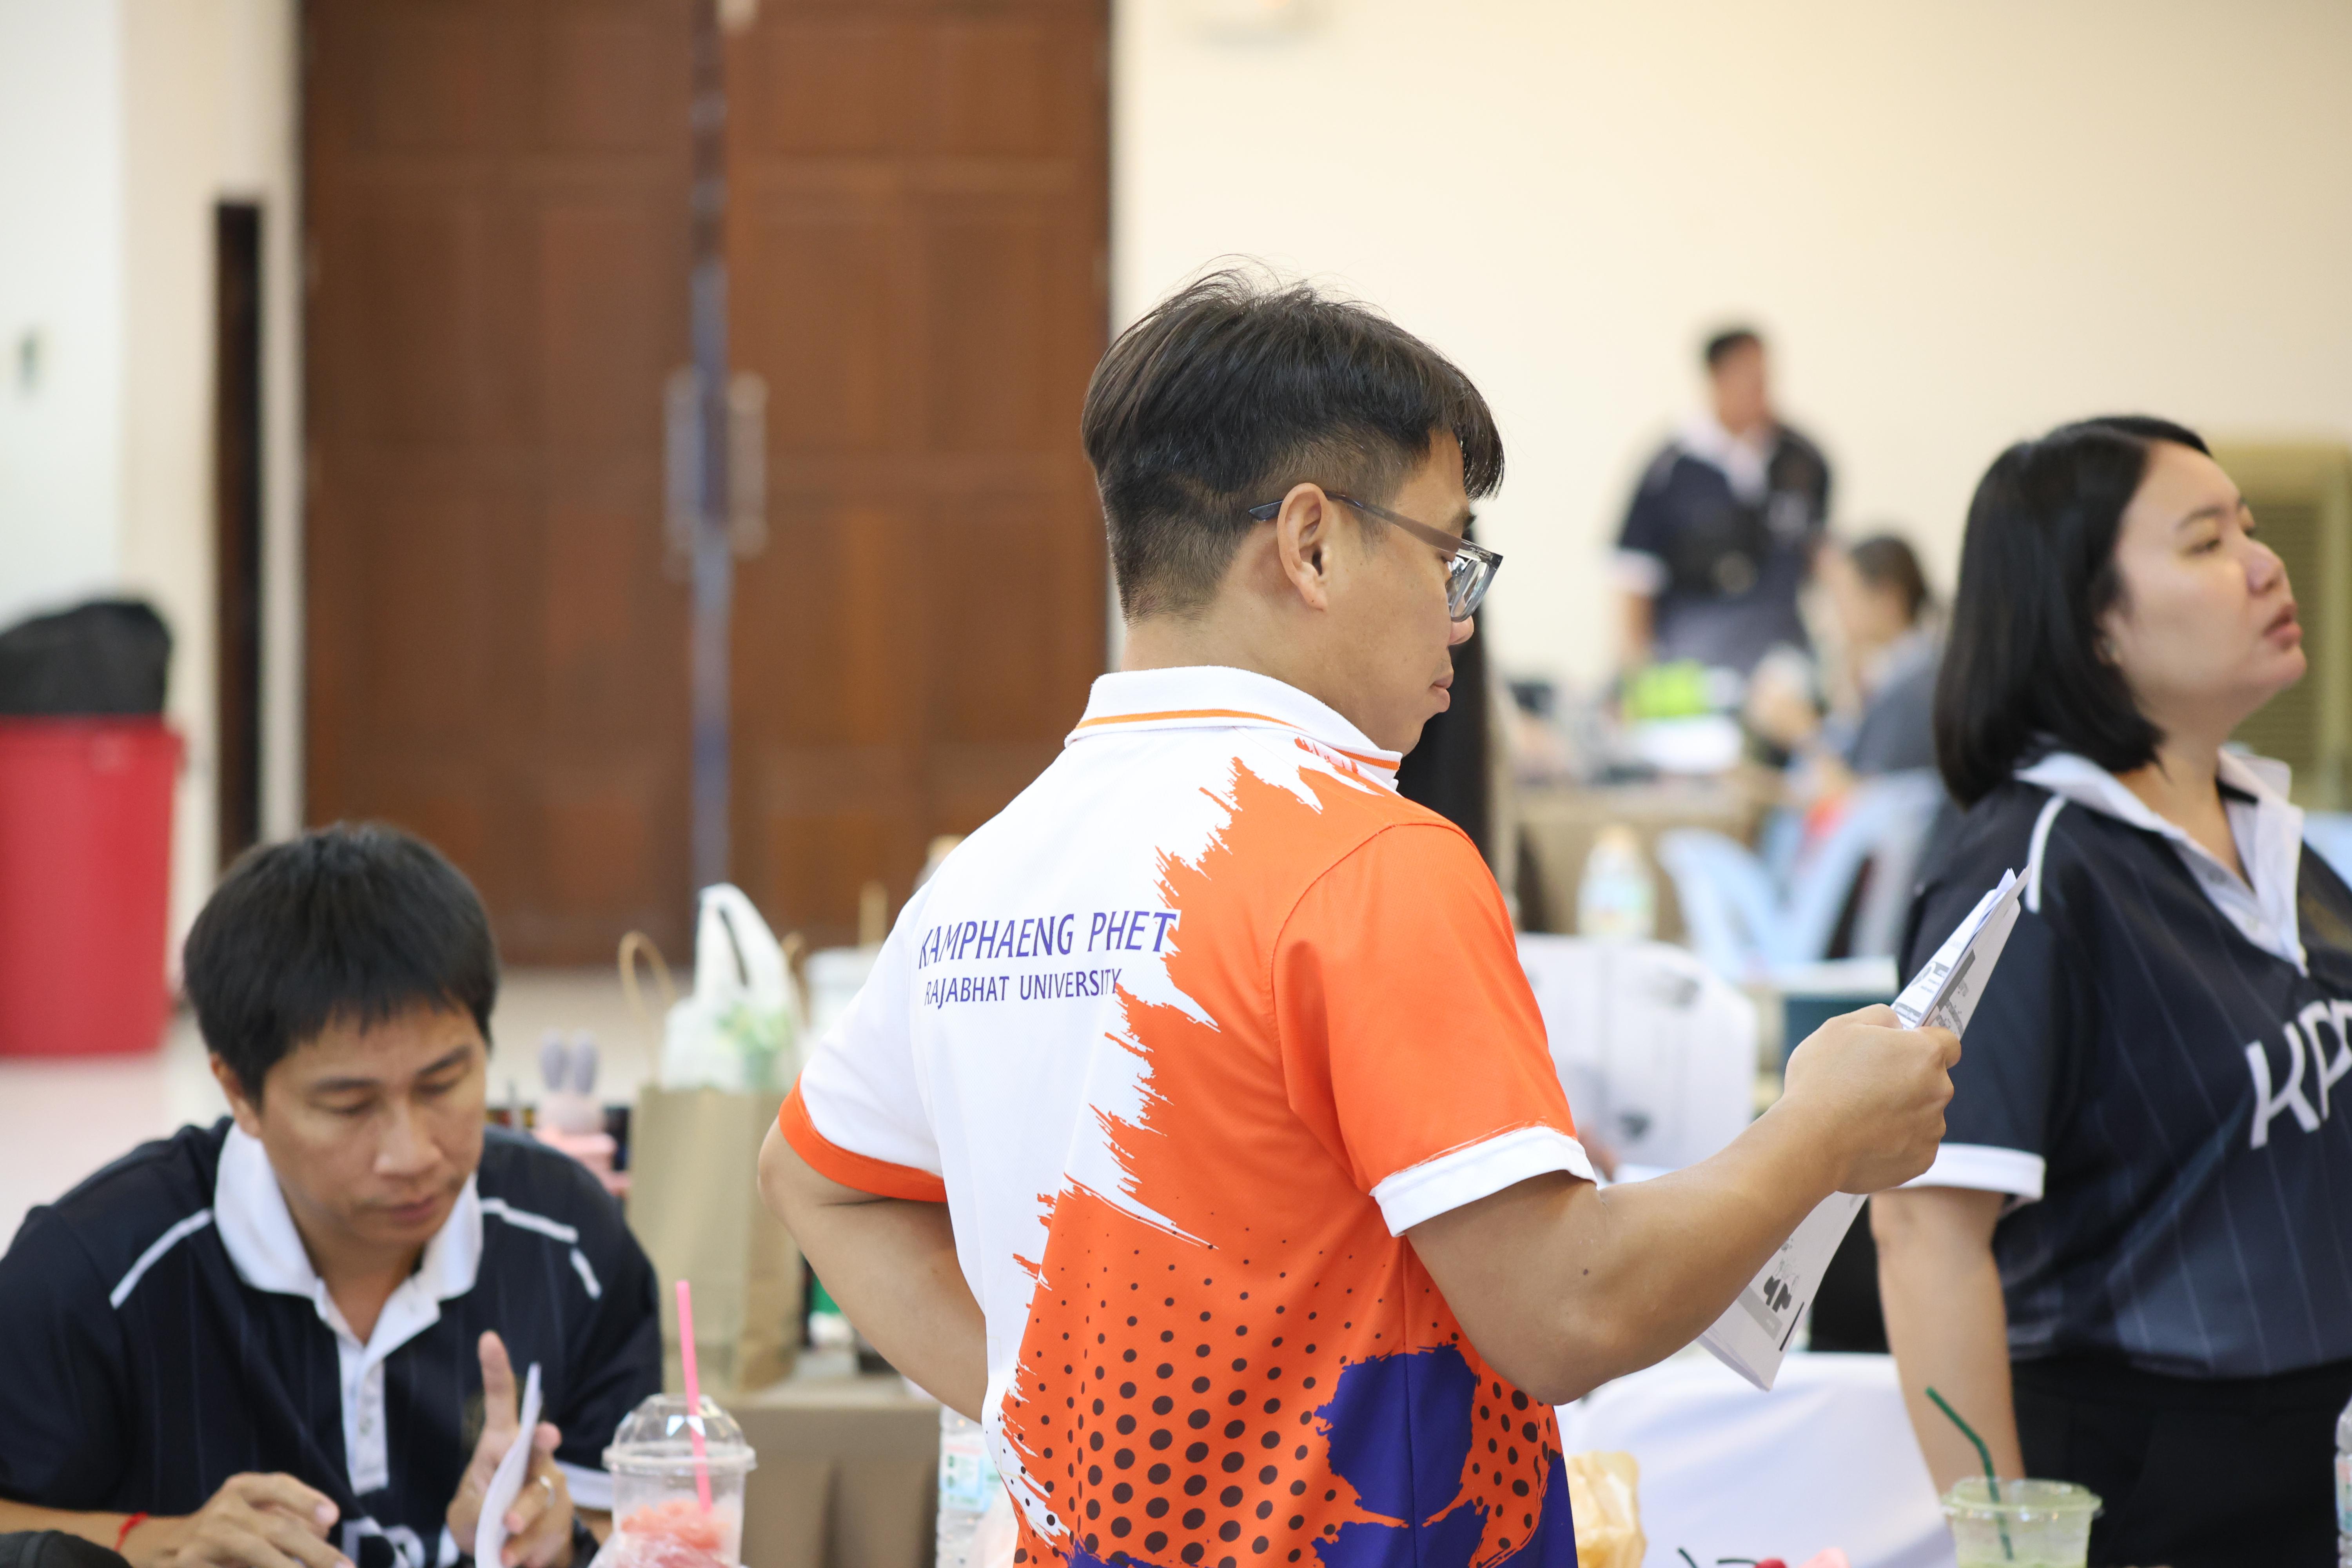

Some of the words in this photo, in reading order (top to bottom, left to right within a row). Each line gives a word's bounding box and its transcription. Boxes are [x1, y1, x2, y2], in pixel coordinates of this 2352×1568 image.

[918, 913, 1074, 970] KAMPHAENG
[1087, 910, 1177, 953] PHET
[924, 976, 1010, 1010] RAJABHAT
[1020, 968, 1122, 1000] UNIVERSITY
